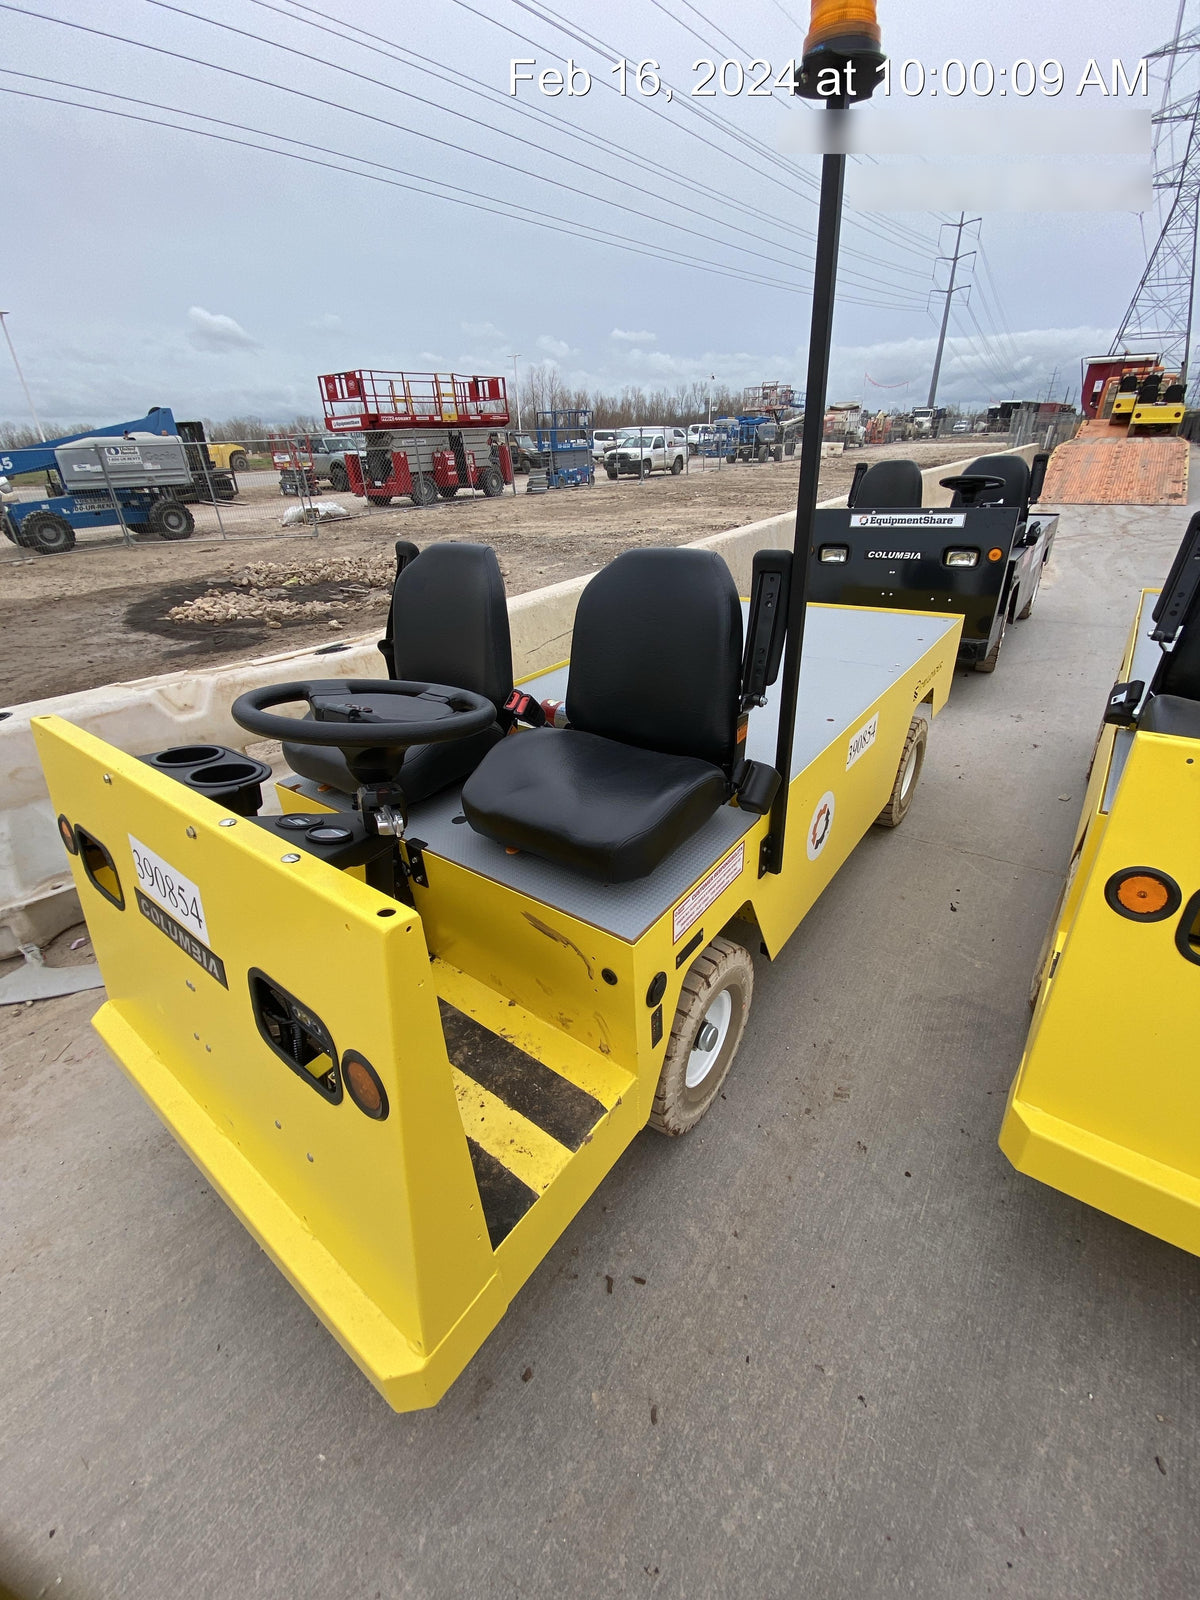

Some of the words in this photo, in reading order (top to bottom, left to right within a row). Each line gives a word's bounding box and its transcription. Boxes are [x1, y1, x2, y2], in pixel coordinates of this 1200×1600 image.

[869, 516, 954, 526] EquipmentShare
[867, 551, 921, 560] COLUMBIA
[846, 720, 877, 765] 390854
[132, 849, 203, 929] 390854
[140, 898, 221, 979] COLUMBIA
